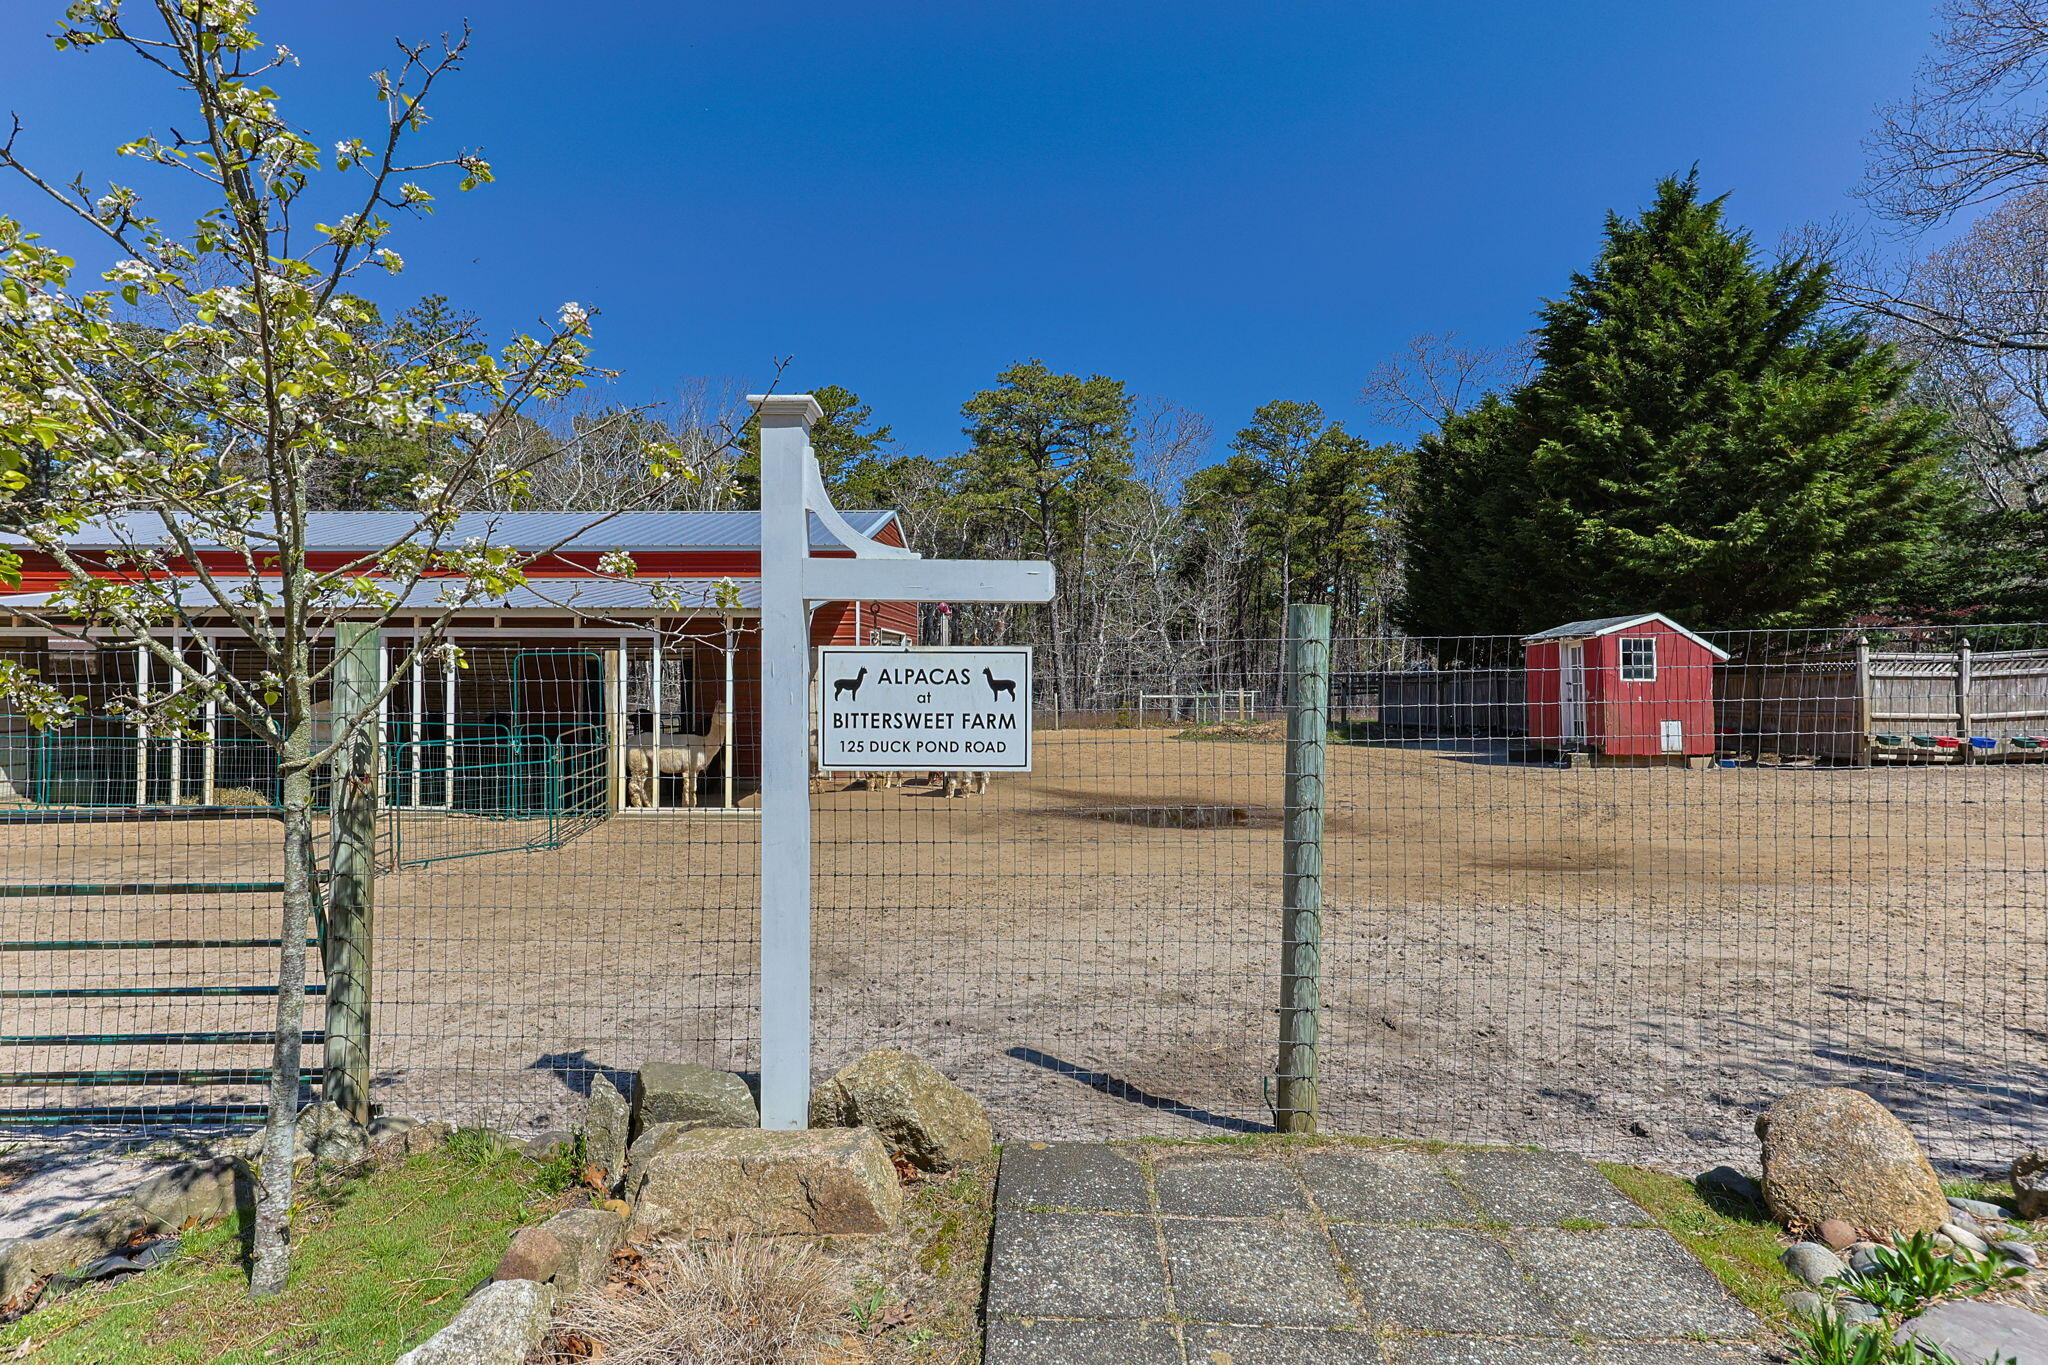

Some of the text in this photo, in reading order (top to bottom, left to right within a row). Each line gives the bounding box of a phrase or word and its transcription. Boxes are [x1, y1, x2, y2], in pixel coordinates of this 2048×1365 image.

[877, 668, 971, 685] ALPACAS
[916, 691, 932, 704] at
[833, 713, 1017, 730] BITTERSWEET FARM
[840, 740, 1007, 753] 125 DUCK POND ROAD
